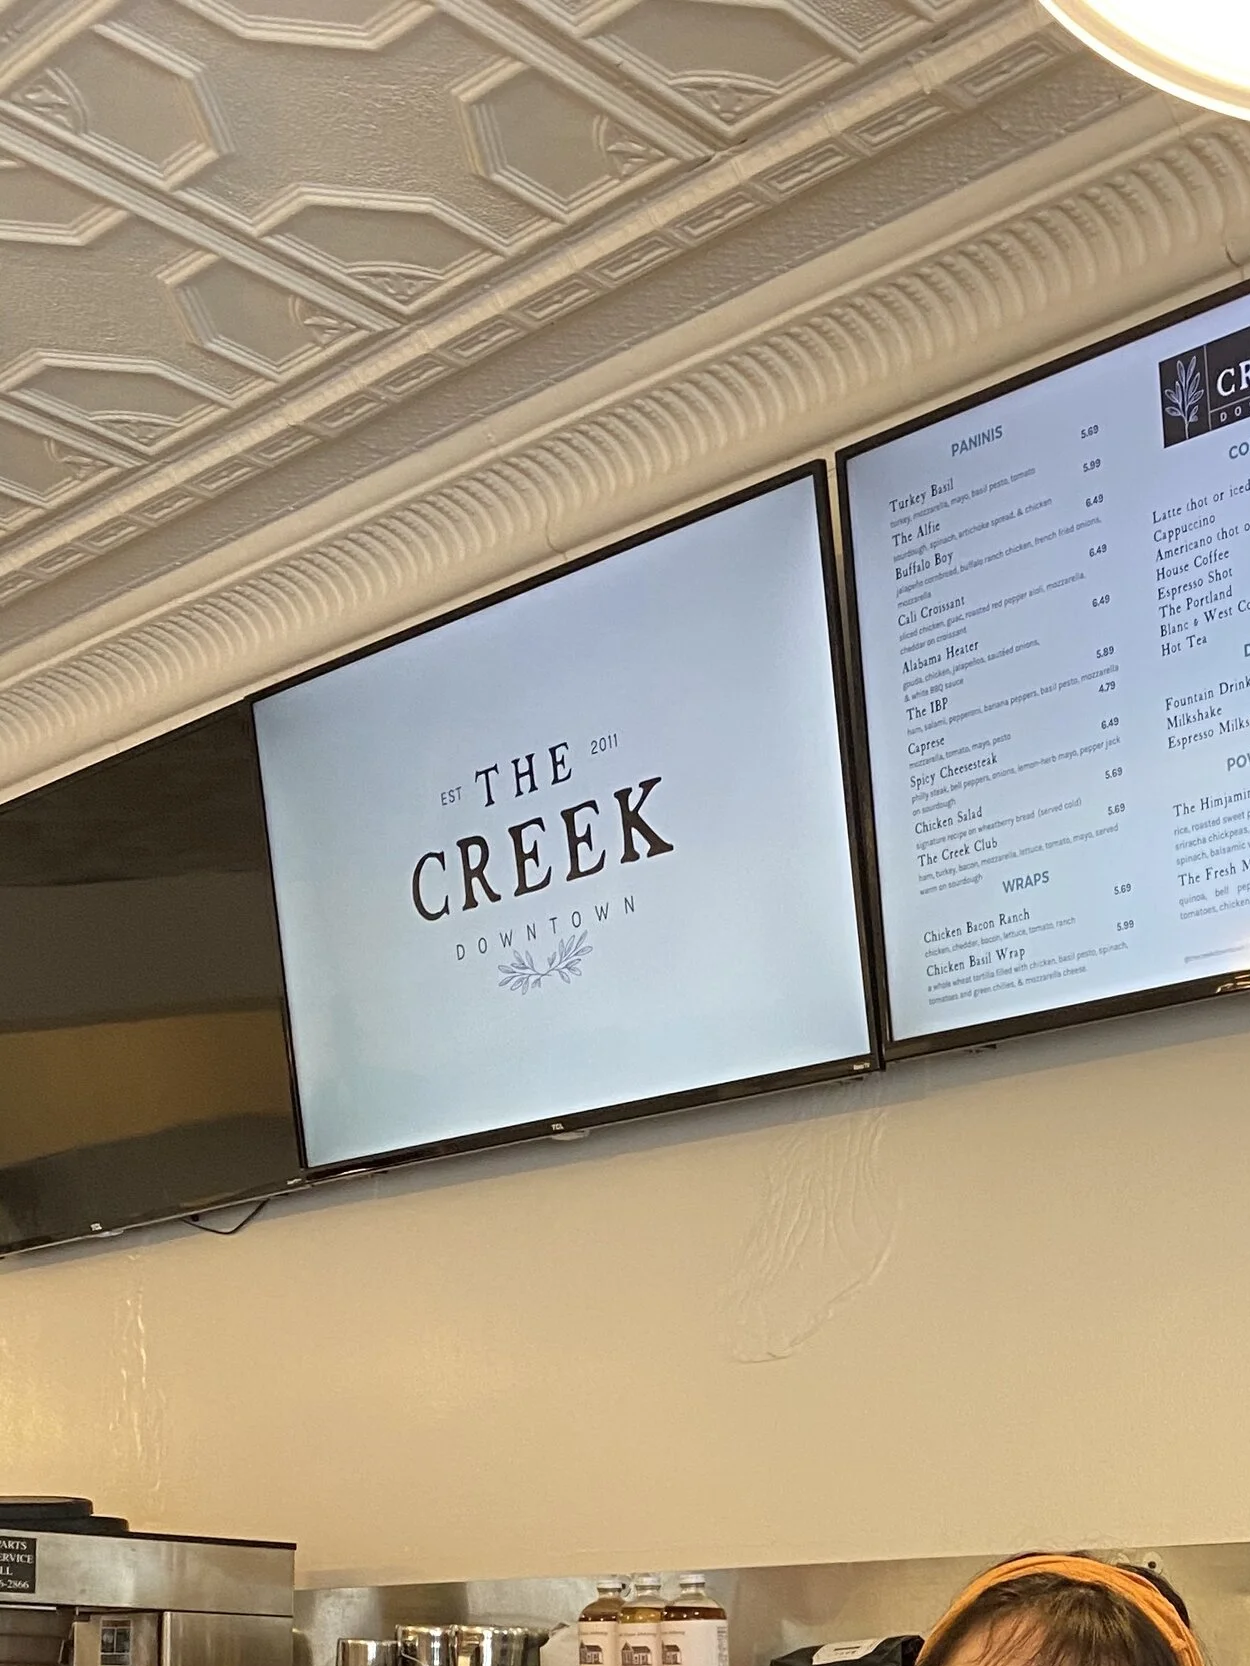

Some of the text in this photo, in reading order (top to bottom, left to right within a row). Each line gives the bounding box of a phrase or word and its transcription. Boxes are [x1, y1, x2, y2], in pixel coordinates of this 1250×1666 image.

[950, 423, 1003, 457] PANINIS
[887, 476, 954, 513] Turkey Basil
[1151, 506, 1182, 525] Latte
[1211, 490, 1225, 503] or
[890, 519, 940, 548] The Alfie
[1152, 513, 1216, 544] Cappuccino
[1154, 534, 1213, 562] Americano
[894, 550, 954, 581] Buffalo Boy
[1155, 547, 1230, 582] House Coffee
[1156, 567, 1233, 601] Espresso Shot
[896, 595, 965, 627] Cali Croissant
[1157, 583, 1233, 619] The Portland
[901, 640, 979, 675] Alabama Heater
[1160, 633, 1208, 657] Hot Tea
[904, 695, 949, 721] The IBP
[1164, 688, 1214, 712] Fountain
[1165, 704, 1222, 730] Milkshake
[906, 736, 945, 757] Caprese
[1166, 728, 1214, 750] Espresso
[440, 733, 619, 807] EST THE 2011
[909, 751, 998, 791] Spicy Cheesesteak
[913, 804, 983, 835] Chicken Salad
[1171, 801, 1196, 818] The
[412, 776, 674, 921] CREEK
[915, 835, 998, 867] The Creek Club
[1000, 869, 1050, 894] WRAPS
[1176, 871, 1201, 887] The
[1204, 861, 1237, 881] Fresh
[456, 895, 635, 961] DOWNTOWN
[922, 906, 1030, 944] Chicken Bacon Ranch
[925, 946, 1026, 977] Chicken Basil Wrap
[0, 1540, 28, 1550] ARTS
